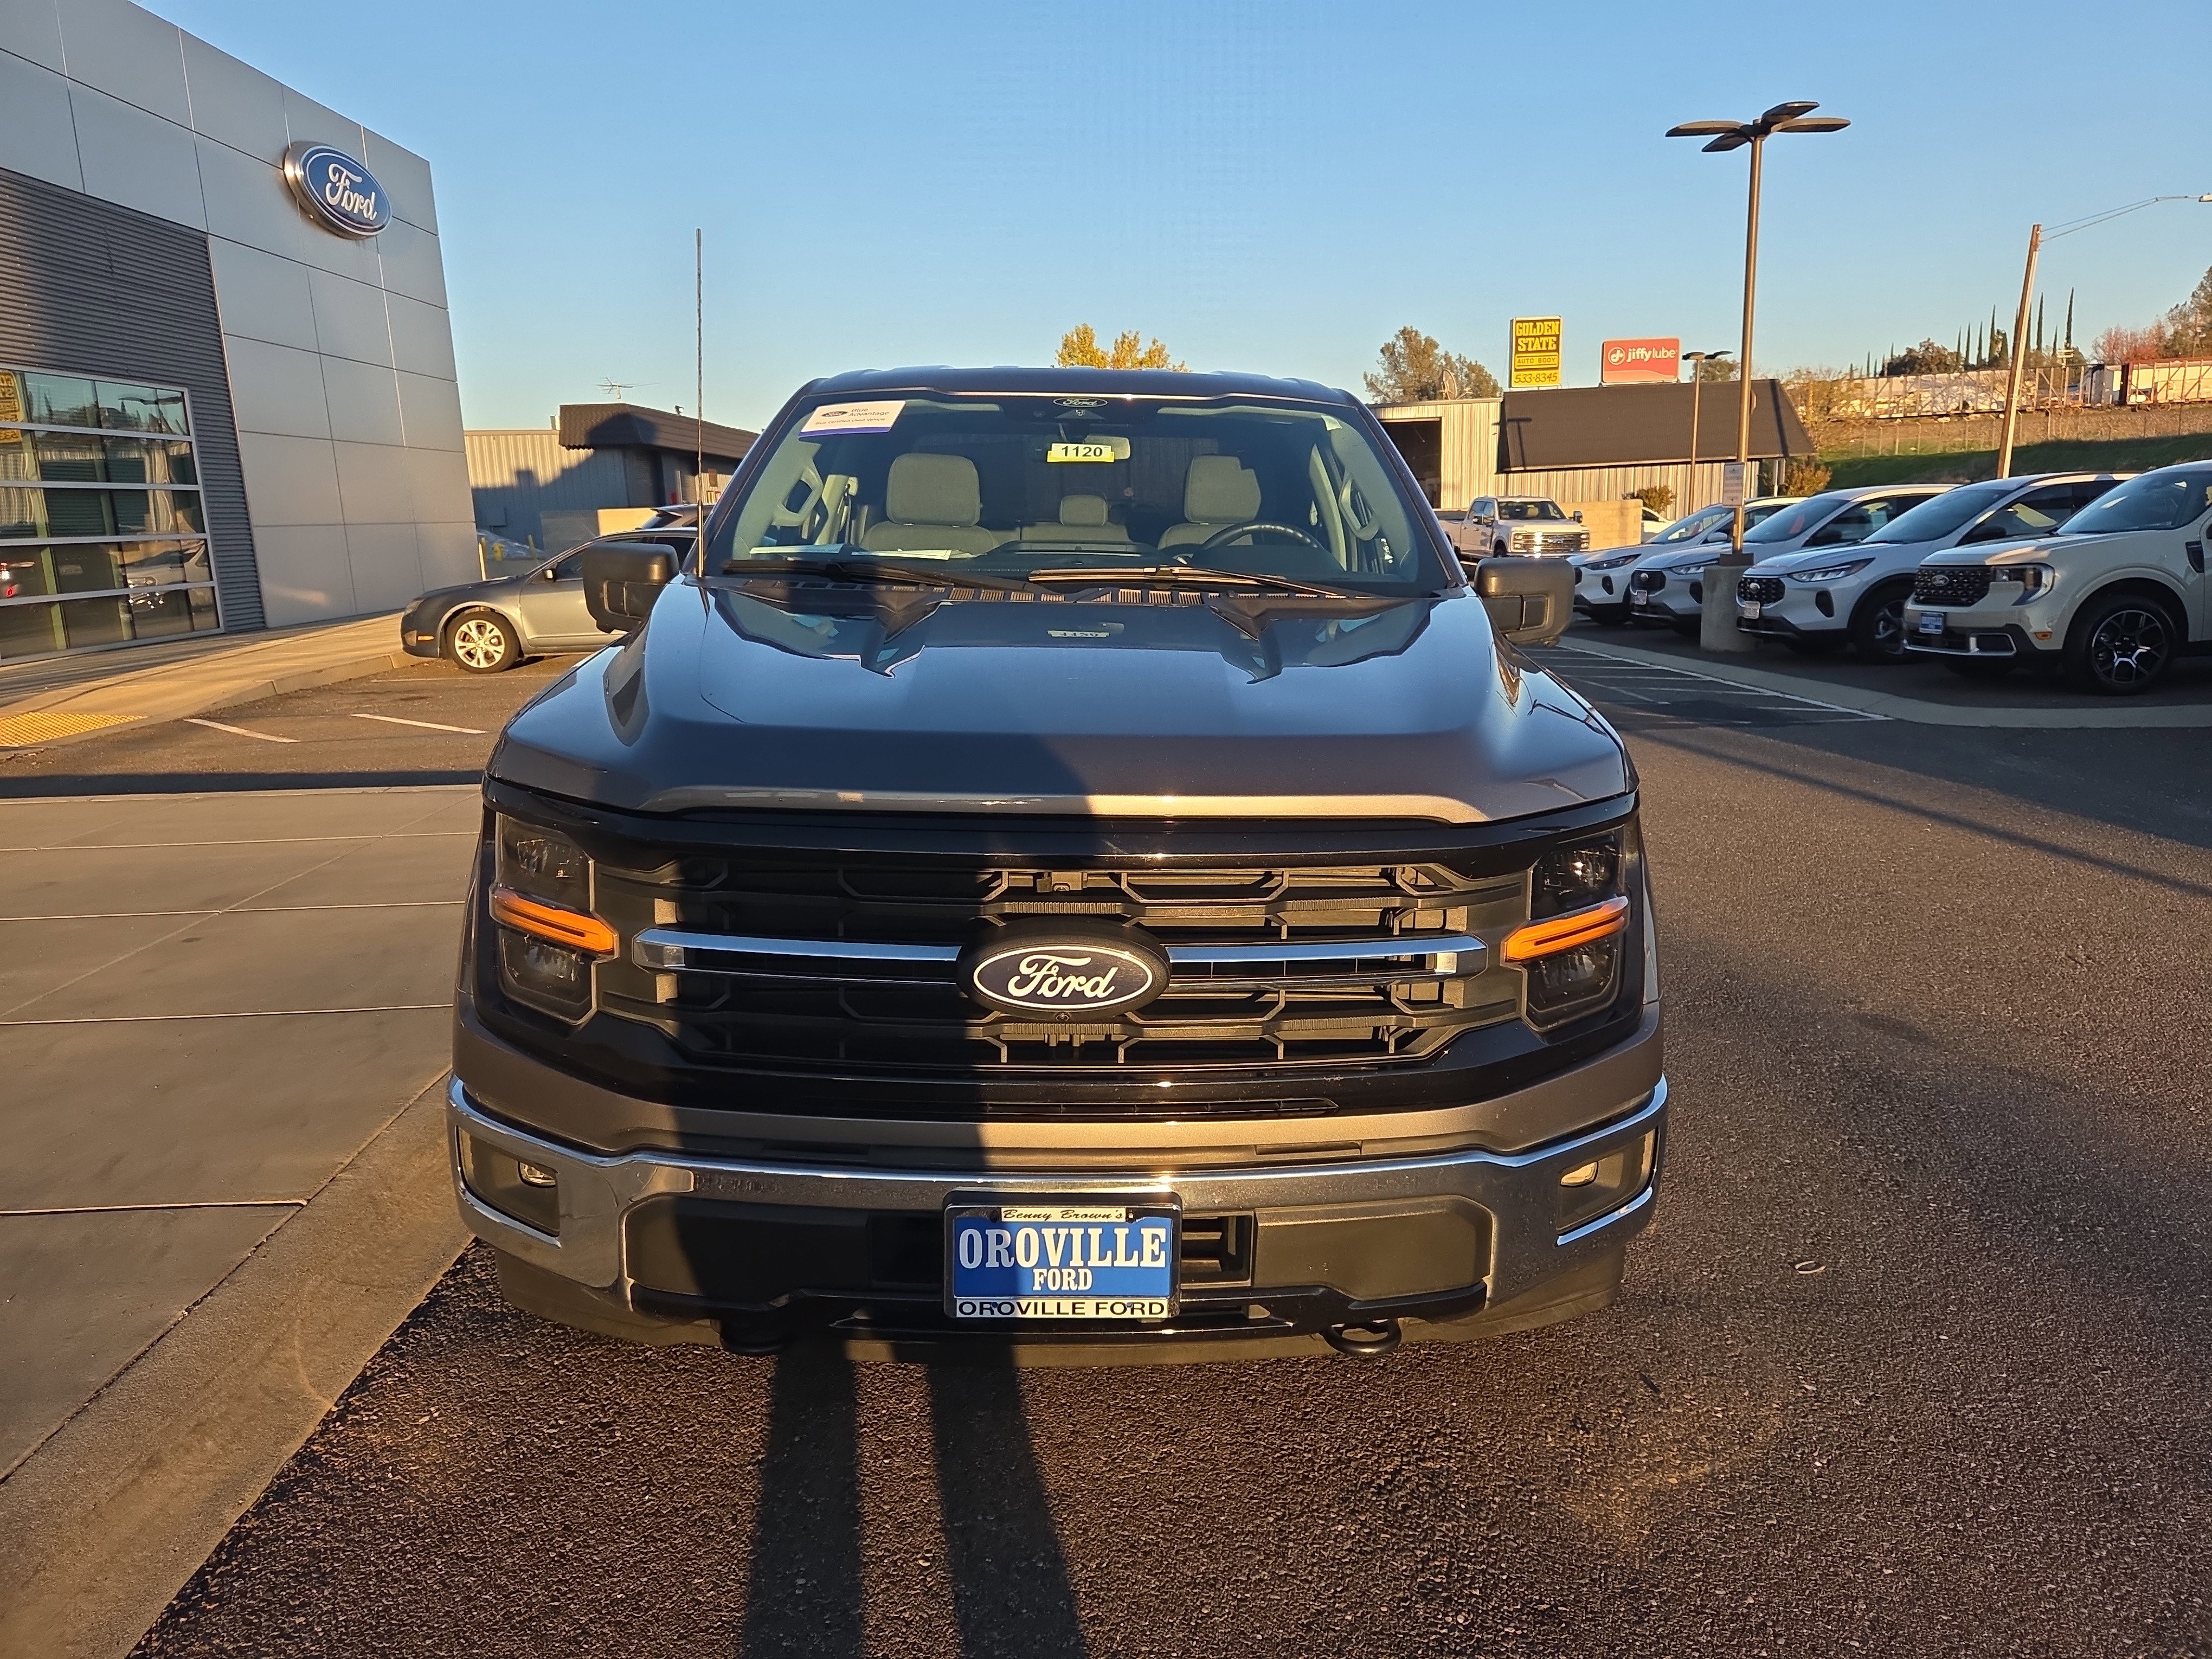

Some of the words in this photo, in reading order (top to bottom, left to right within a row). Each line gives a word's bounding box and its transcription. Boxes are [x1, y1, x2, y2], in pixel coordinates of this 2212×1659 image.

[325, 163, 377, 220] Ford
[1516, 321, 1560, 336] GOLDEN
[1517, 337, 1557, 351] STATE
[1514, 372, 1558, 383] 533-8345
[1063, 397, 1098, 406] Ford
[1062, 446, 1103, 457] 1120
[1007, 954, 1118, 999] Ford
[1002, 1209, 1052, 1221] Benny
[1060, 1209, 1124, 1219] Brown's
[959, 1227, 1166, 1269] OROVILLE
[1033, 1268, 1092, 1291] FORD
[959, 1302, 1085, 1315] OROVILLE
[1095, 1302, 1165, 1315] FORD
